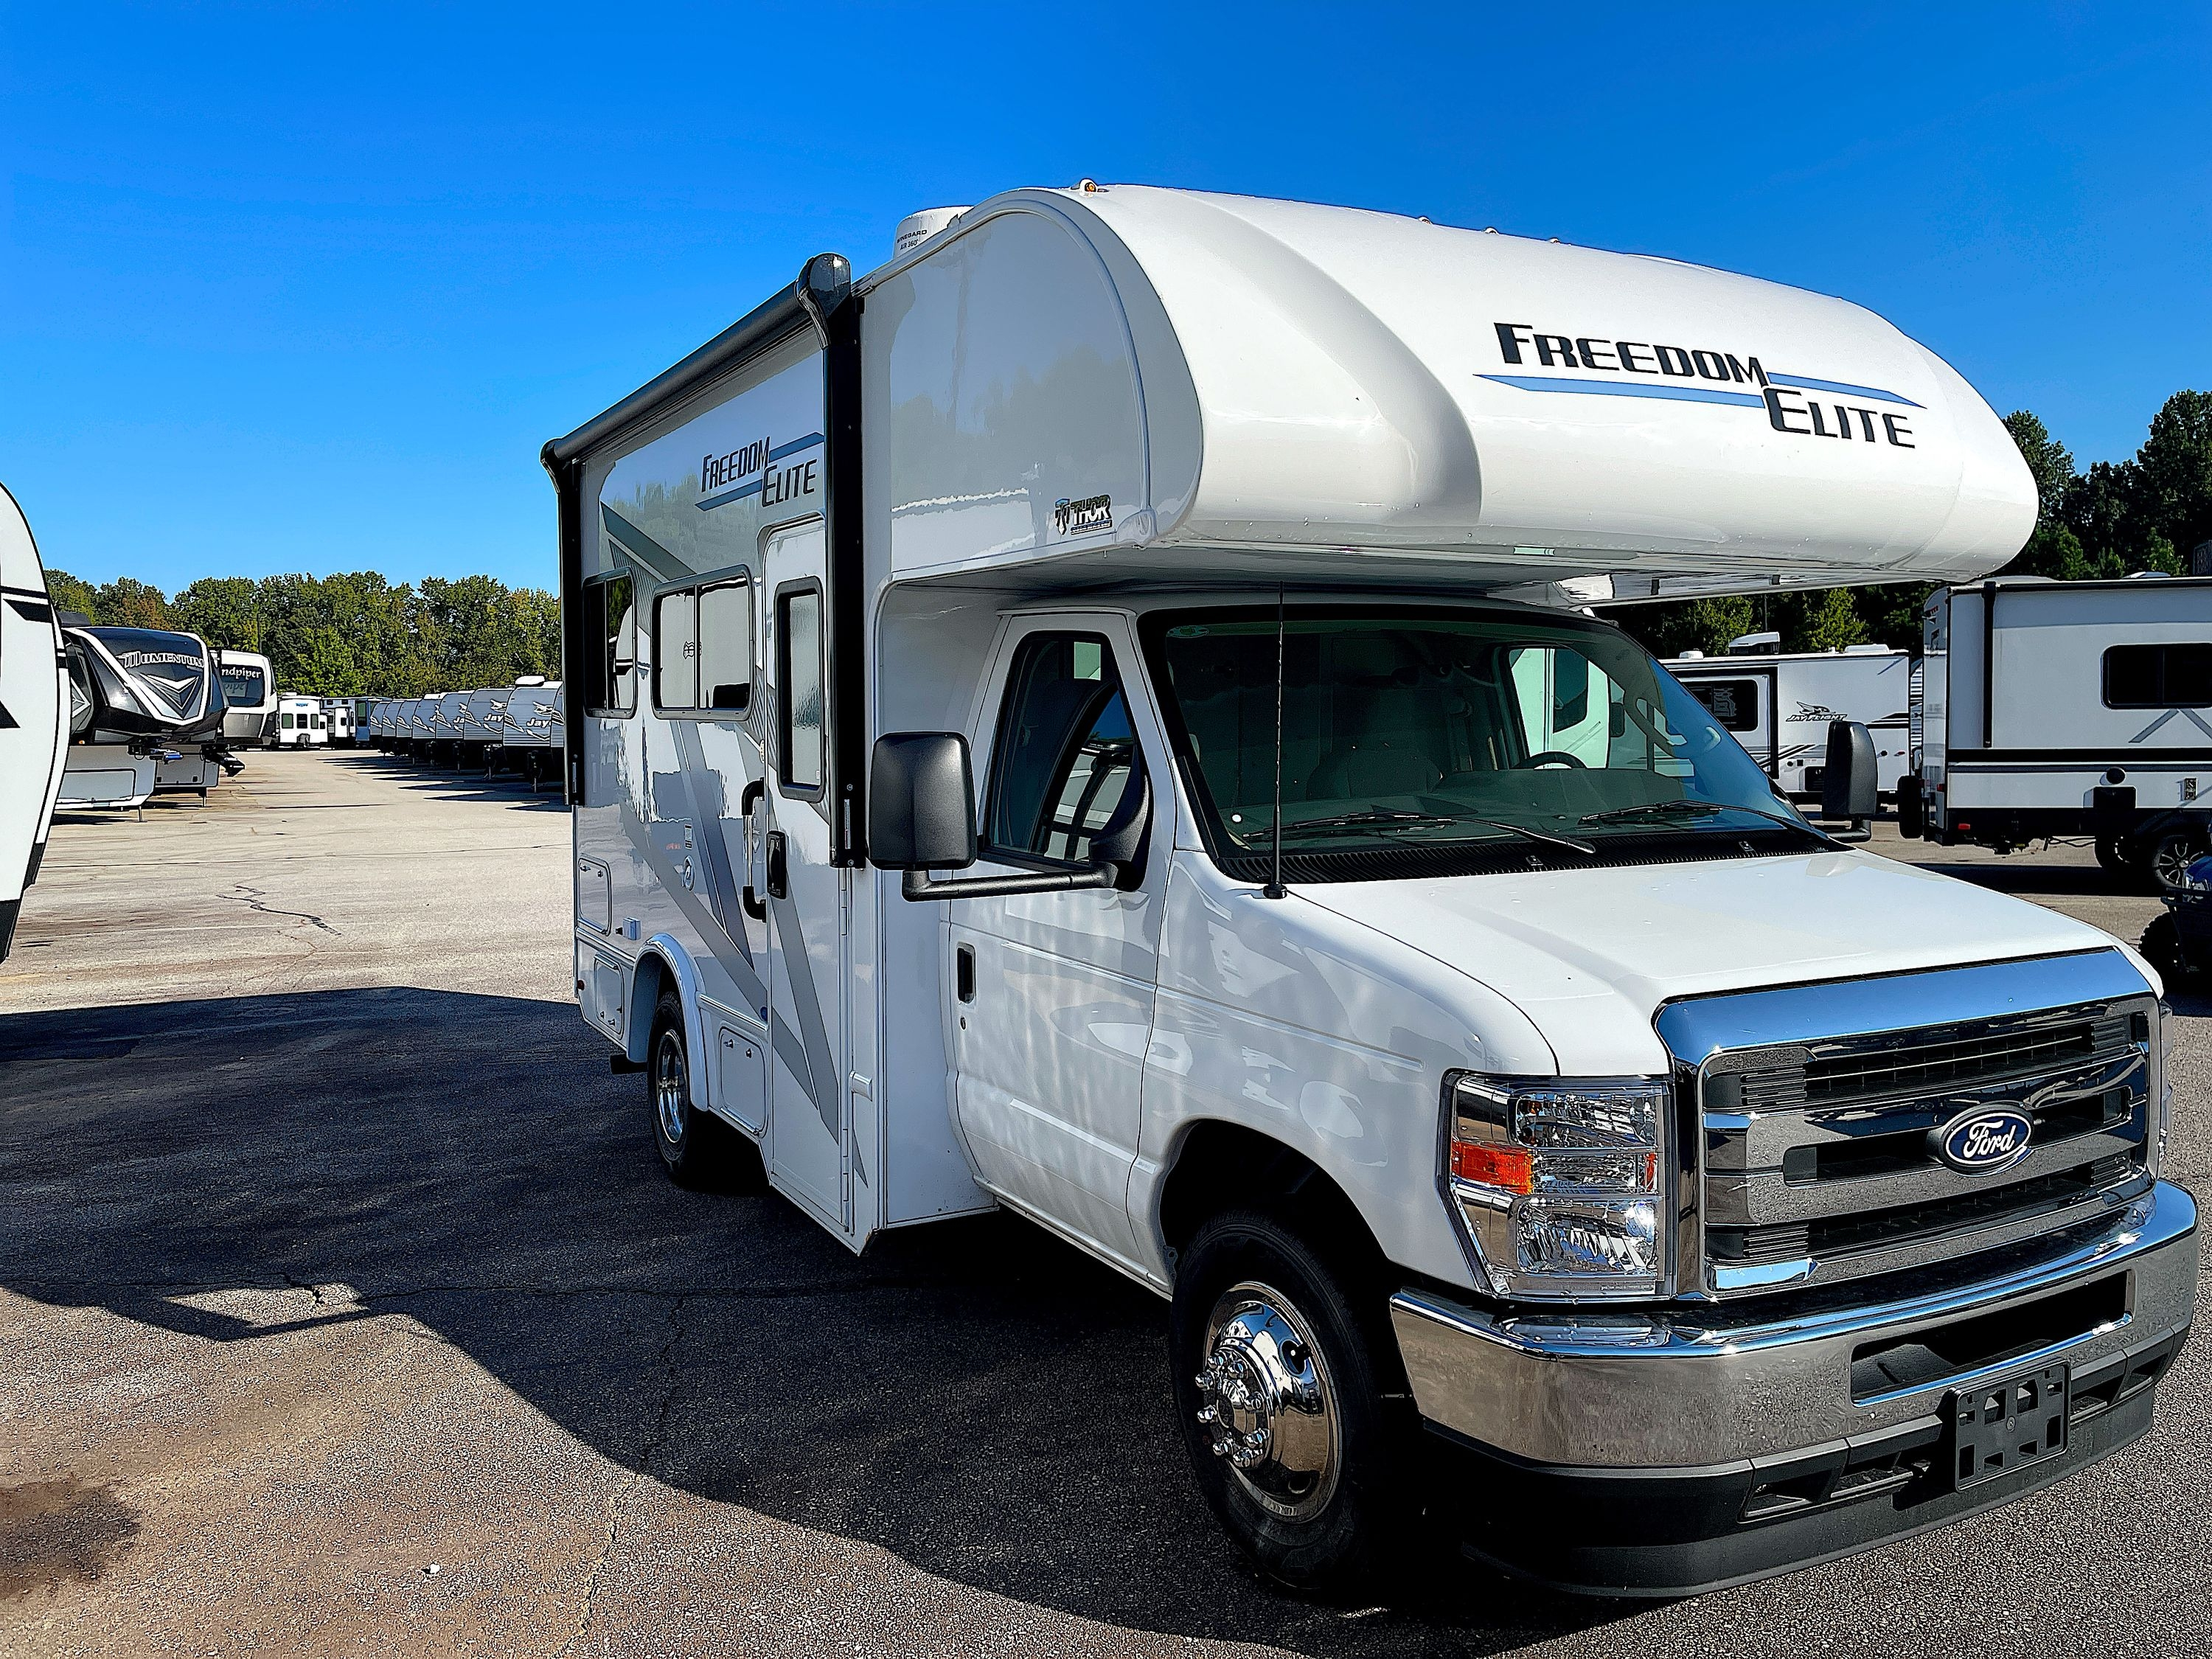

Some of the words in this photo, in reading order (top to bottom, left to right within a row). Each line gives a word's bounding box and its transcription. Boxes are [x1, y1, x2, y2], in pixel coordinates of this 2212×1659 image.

[1494, 322, 1769, 387] FREEDOM
[1763, 388, 1916, 449] ELITE
[701, 436, 770, 493] FREEDOM
[762, 459, 818, 507] ELITE
[1071, 494, 1113, 526] THOR
[1964, 1120, 2017, 1158] Ford
